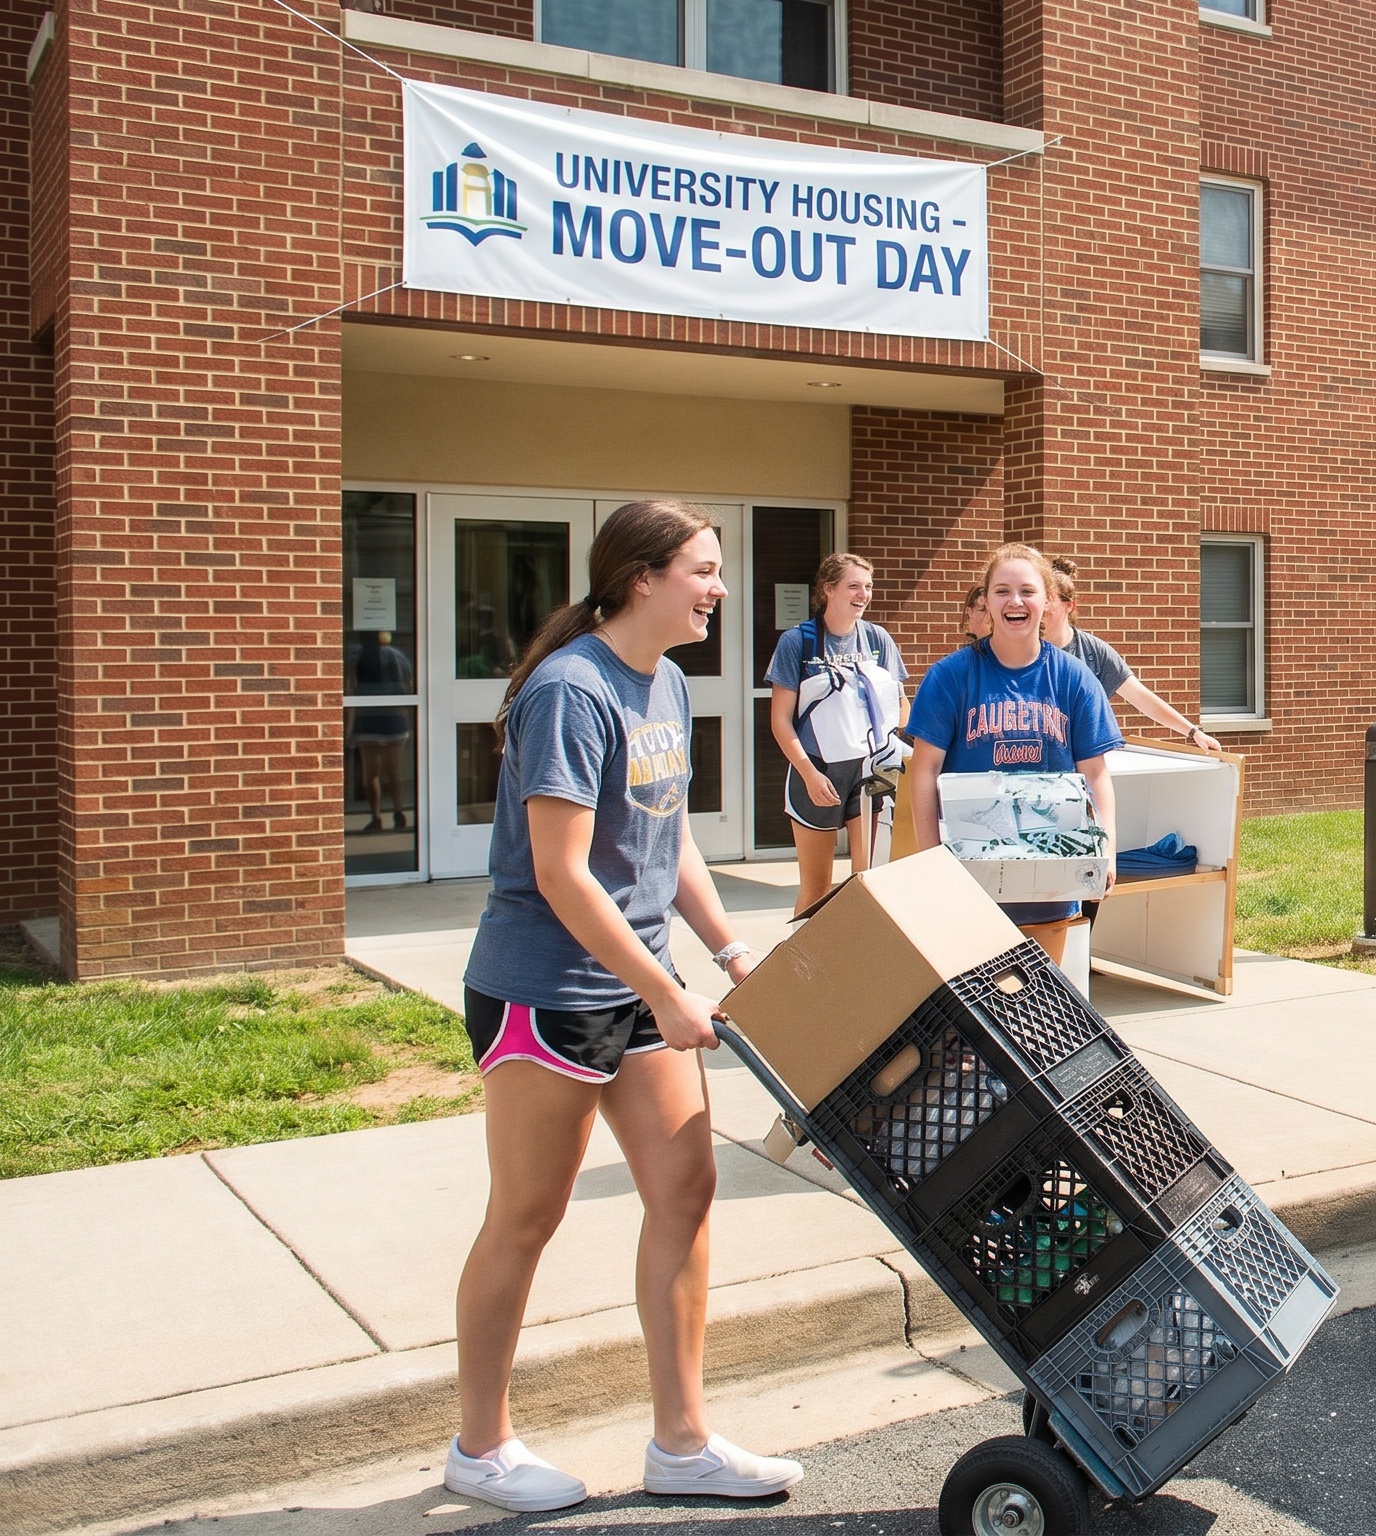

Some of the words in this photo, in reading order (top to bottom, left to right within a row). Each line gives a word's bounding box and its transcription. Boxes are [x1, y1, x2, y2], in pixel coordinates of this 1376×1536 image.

[556, 152, 780, 214] UNIVERSITY
[792, 183, 940, 234] HOUSING
[552, 200, 857, 286] MOVE-OUT
[876, 239, 972, 297] DAY
